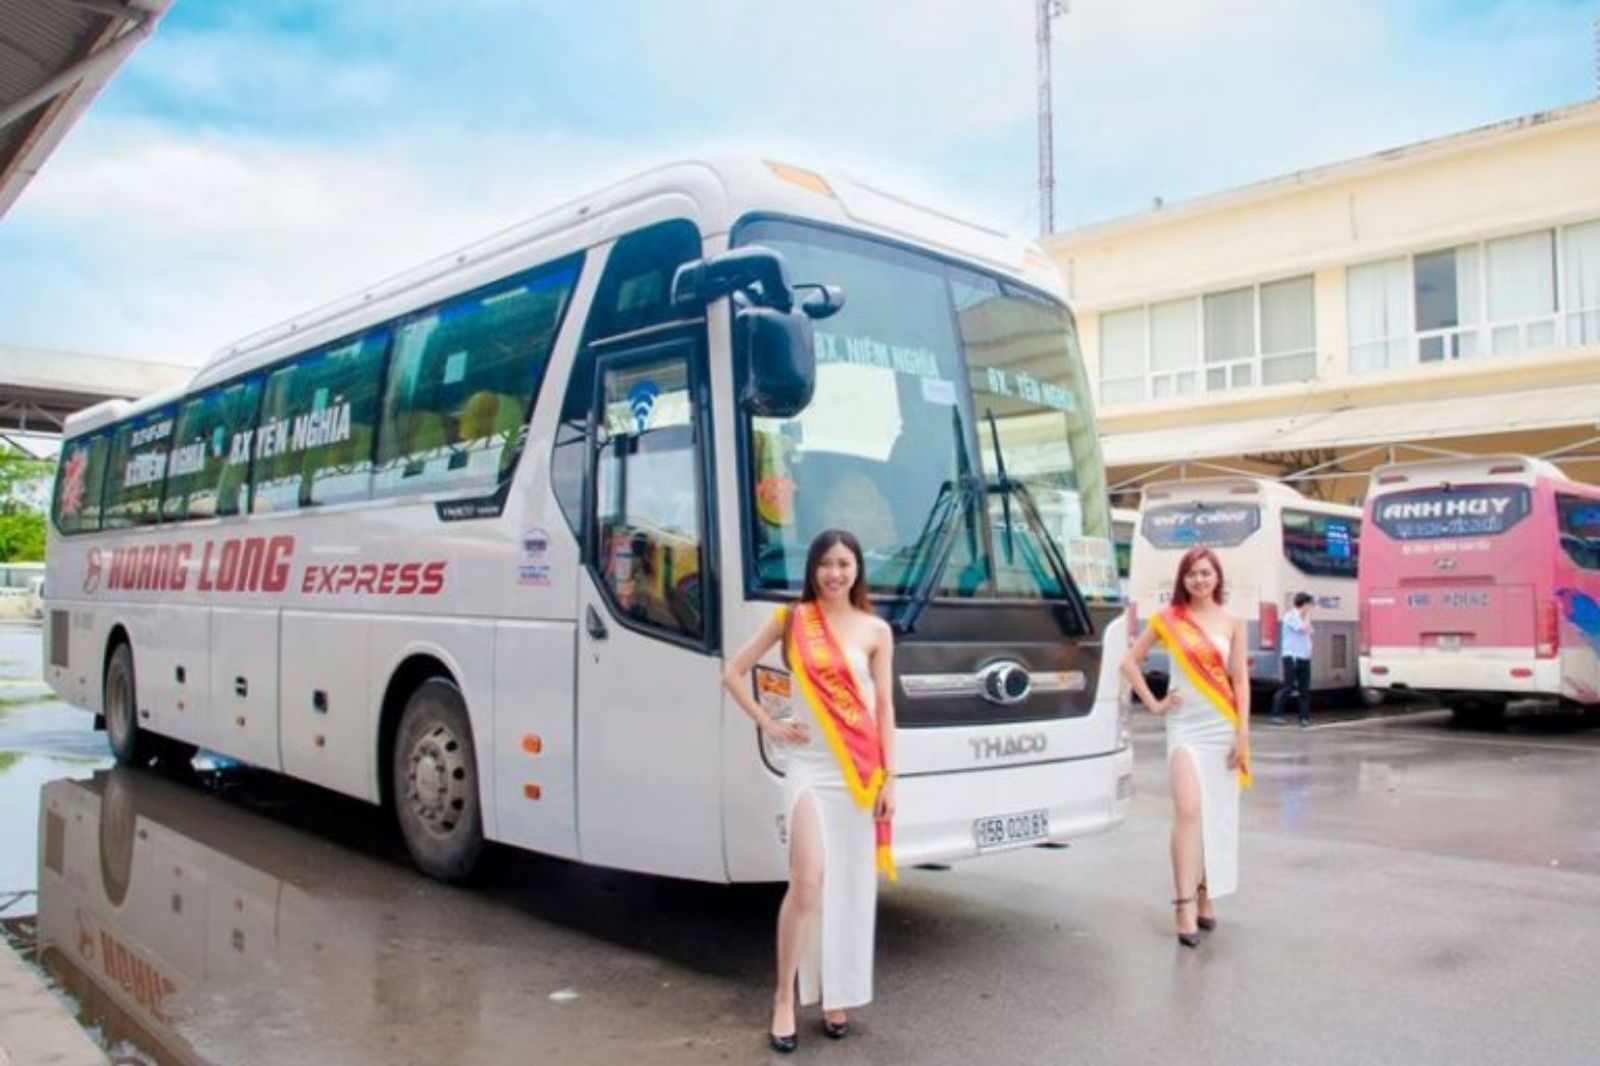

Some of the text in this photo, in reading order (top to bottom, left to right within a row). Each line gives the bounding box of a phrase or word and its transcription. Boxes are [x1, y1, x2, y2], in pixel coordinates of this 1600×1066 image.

[292, 394, 351, 451] NGHĨA
[1383, 497, 1512, 520] ANH HUY
[196, 535, 295, 593] LONG
[301, 561, 447, 594] EXPRESS
[967, 732, 1047, 759] THACO
